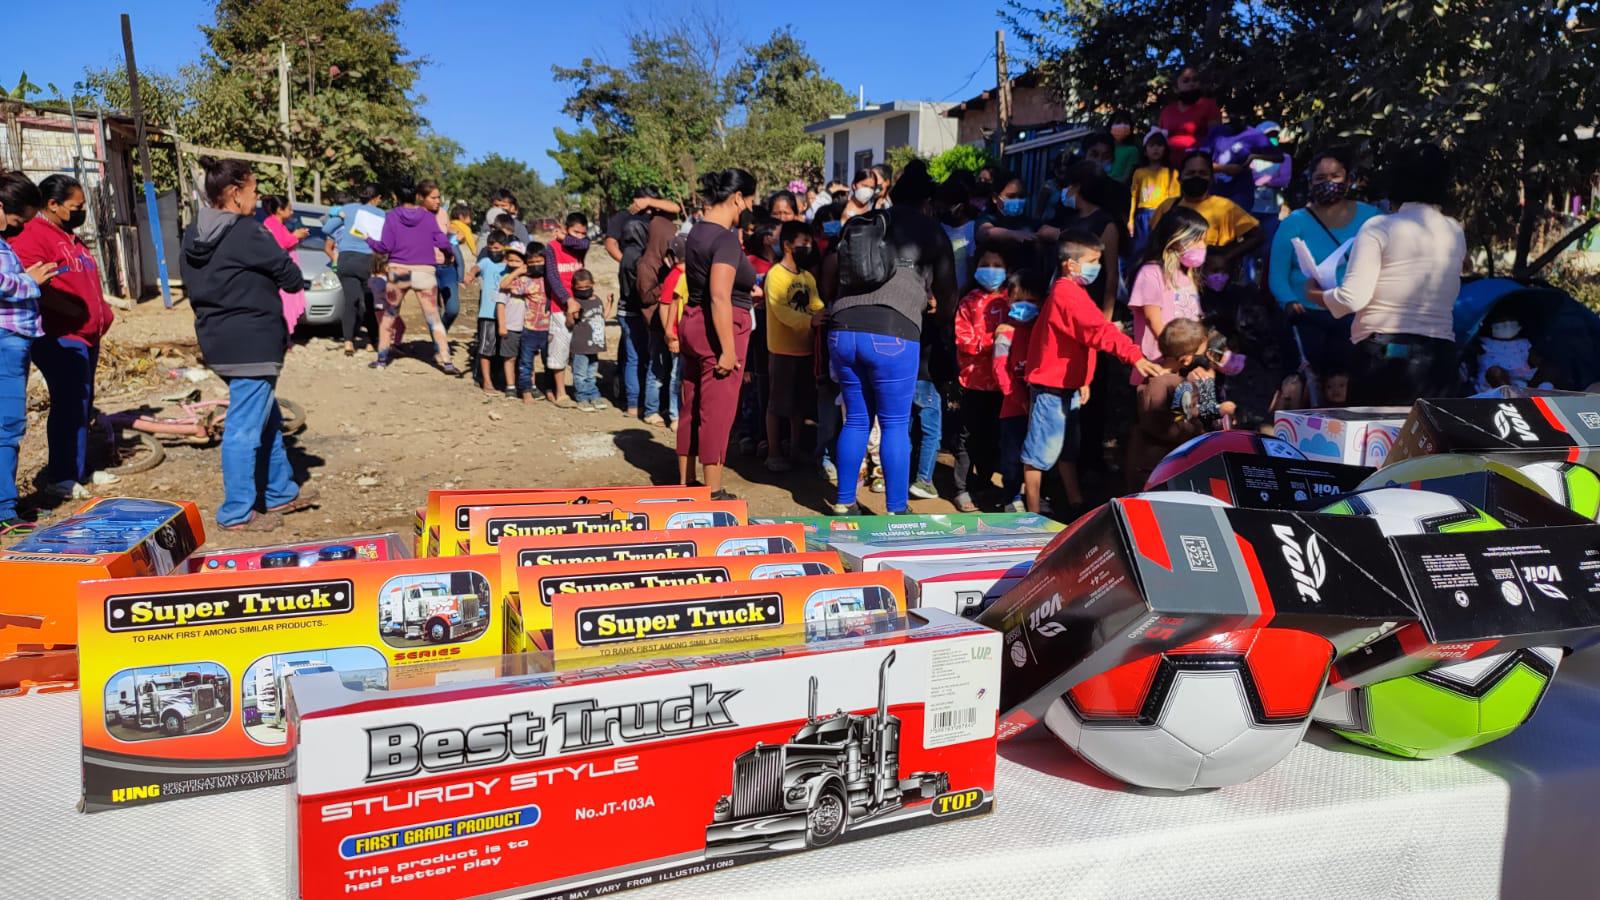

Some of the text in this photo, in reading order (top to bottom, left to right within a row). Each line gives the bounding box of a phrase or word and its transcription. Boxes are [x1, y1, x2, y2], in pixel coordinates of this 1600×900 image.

[1498, 403, 1540, 441] Voit
[1314, 483, 1340, 496] Voit
[572, 519, 634, 534] Truck
[1271, 523, 1322, 604] Voit
[1522, 564, 1563, 583] Voit
[130, 588, 332, 625] Super Truck
[597, 602, 766, 638] Super Truck
[1028, 592, 1063, 631] Voit
[132, 635, 145, 643] TO
[147, 632, 174, 642] RANK
[176, 630, 201, 640] FIRST
[203, 627, 237, 638] AMONG
[239, 623, 274, 635] SIMILAR
[612, 647, 635, 656] RANK
[636, 645, 657, 654] FIRST
[659, 641, 687, 652] AMONG
[688, 637, 719, 648] SIMILAR
[394, 647, 461, 661] SERIES
[363, 683, 743, 784] Best Truck
[111, 784, 161, 803] KING
[162, 773, 240, 790] SPECIFICATIONS
[162, 782, 216, 796] CONTENTS
[216, 779, 238, 789] MAY
[240, 774, 266, 785] VARY
[320, 755, 640, 823] STURDY STYLE
[575, 795, 656, 821] No.JT-103A
[938, 791, 978, 814] TOP
[355, 811, 522, 854] FIRST GRADE PRODUCT
[344, 838, 529, 881] This product is to
[344, 855, 502, 894] had better play
[569, 890, 590, 900] MAY
[595, 883, 623, 895] VARY
[626, 876, 653, 888] FROM
[658, 859, 736, 881] ILLUSTRATIONS
